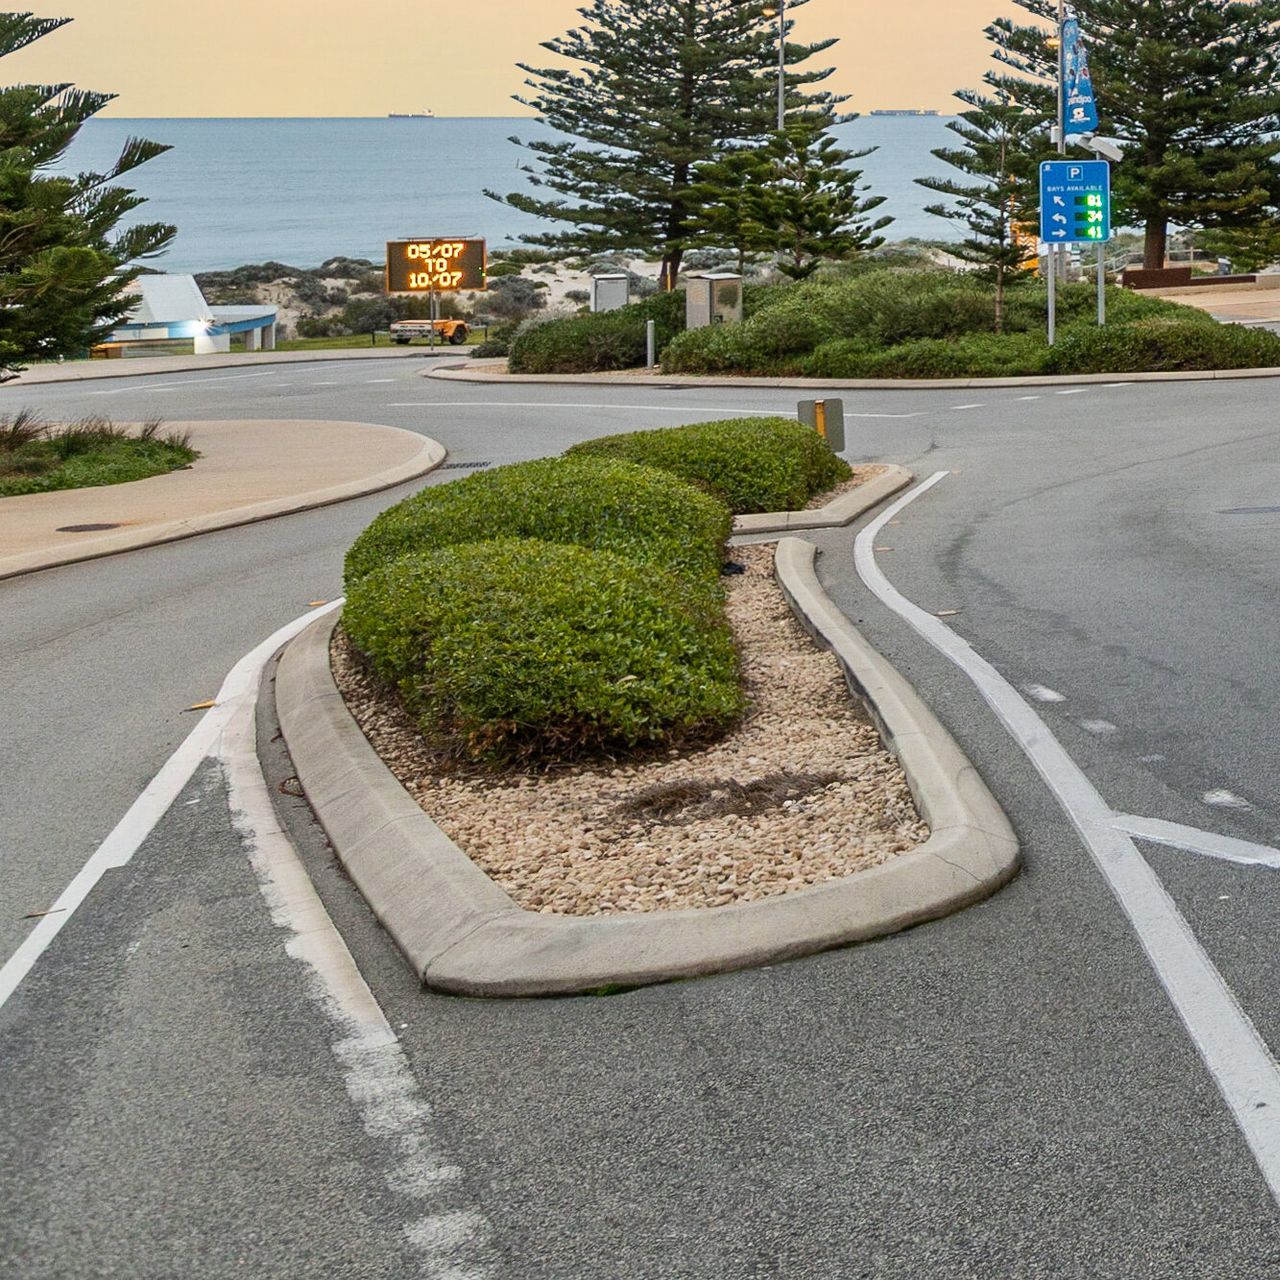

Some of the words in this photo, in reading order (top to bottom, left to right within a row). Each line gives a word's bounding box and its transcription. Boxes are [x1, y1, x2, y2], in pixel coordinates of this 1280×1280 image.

[1070, 168, 1080, 179] P
[1066, 184, 1103, 192] AVAILABLE
[1087, 210, 1103, 222] 34
[1087, 225, 1103, 238] 41
[407, 243, 464, 258] 05/07
[424, 258, 447, 272] TO
[409, 272, 462, 287] 10/07
